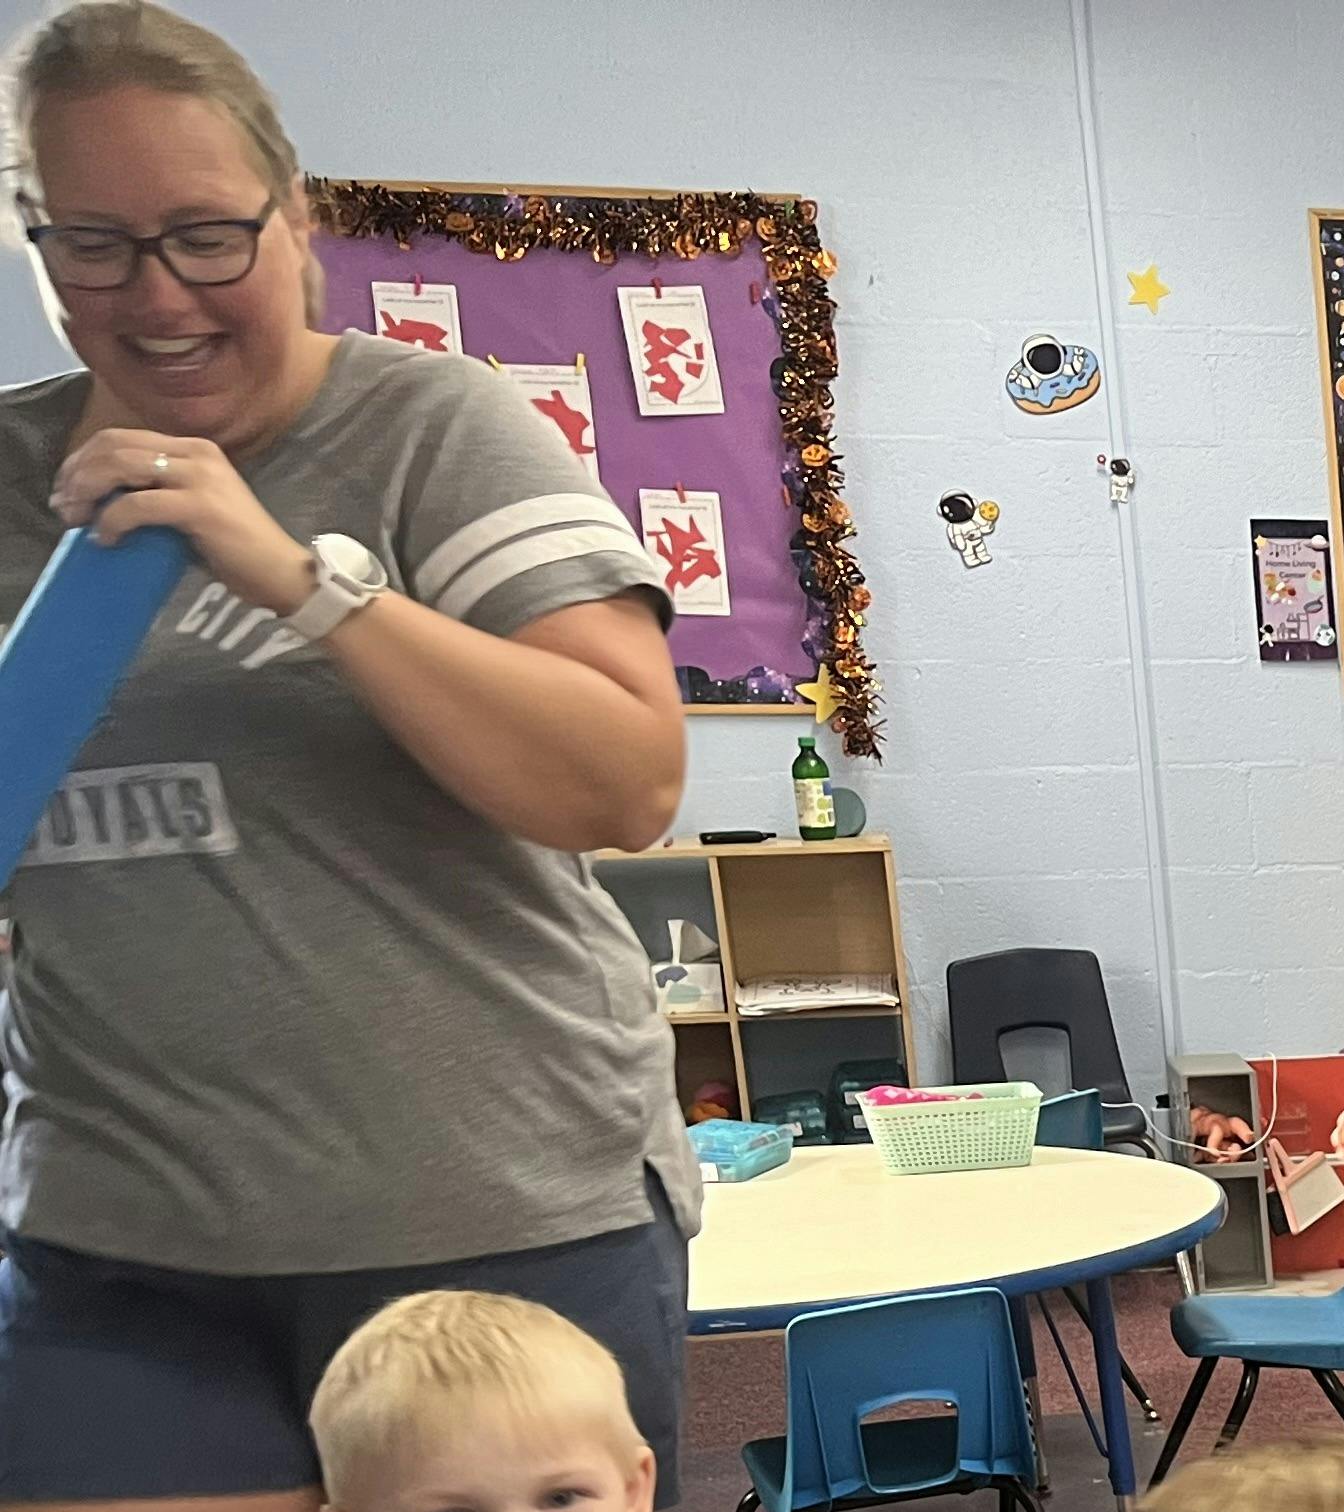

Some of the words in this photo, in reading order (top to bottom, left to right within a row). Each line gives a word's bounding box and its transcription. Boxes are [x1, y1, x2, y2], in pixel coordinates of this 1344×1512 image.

[1265, 560, 1291, 568] Home
[1292, 560, 1316, 569] Living
[175, 582, 309, 671] CITY
[28, 777, 213, 850] OYALS
